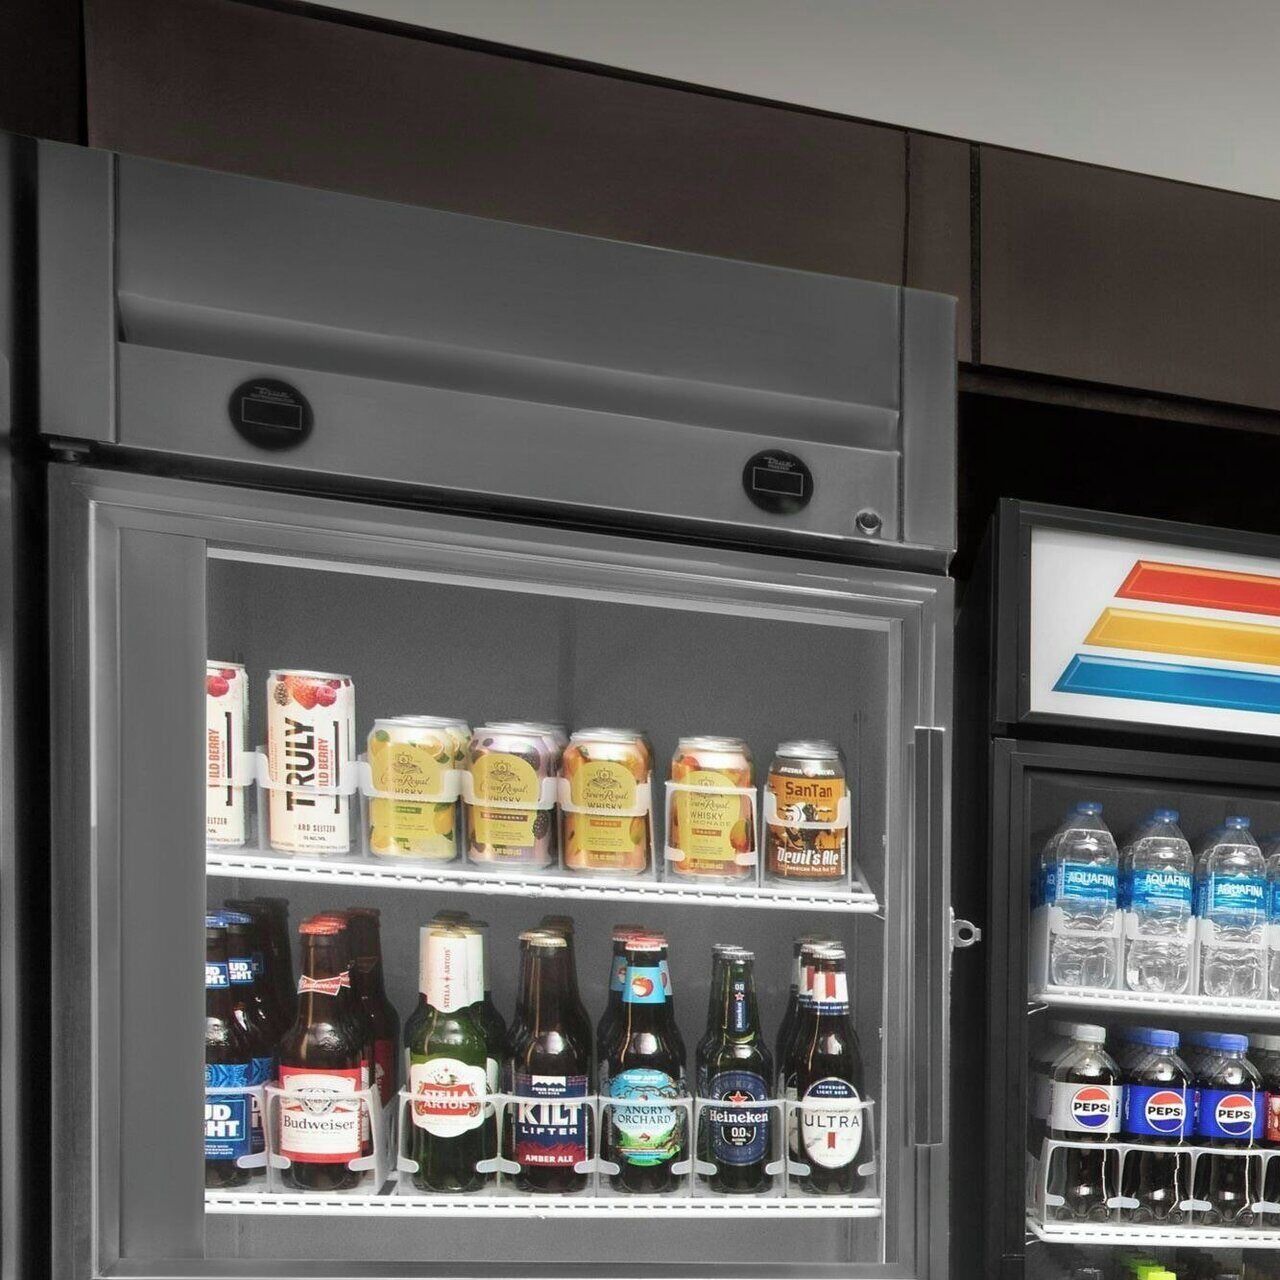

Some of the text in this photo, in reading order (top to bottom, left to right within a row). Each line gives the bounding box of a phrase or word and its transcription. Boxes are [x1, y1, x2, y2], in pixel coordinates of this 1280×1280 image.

[318, 738, 328, 773] BERRY
[285, 717, 315, 811] TRULY
[785, 782, 833, 797] SanTan
[777, 848, 838, 866] Devil's Ale
[1068, 871, 1115, 888] AQUAFINA
[518, 1104, 582, 1126] KILT
[624, 1106, 664, 1116] ANGRY
[1073, 1102, 1110, 1114] PEPSI
[284, 1115, 354, 1131] Budweiser
[618, 1114, 671, 1125] ORCHARD
[710, 1109, 769, 1123] Heineken
[804, 1113, 860, 1128] ULTRA
[522, 1126, 577, 1135] LIFTER
[525, 1154, 573, 1163] AMBER ALE
